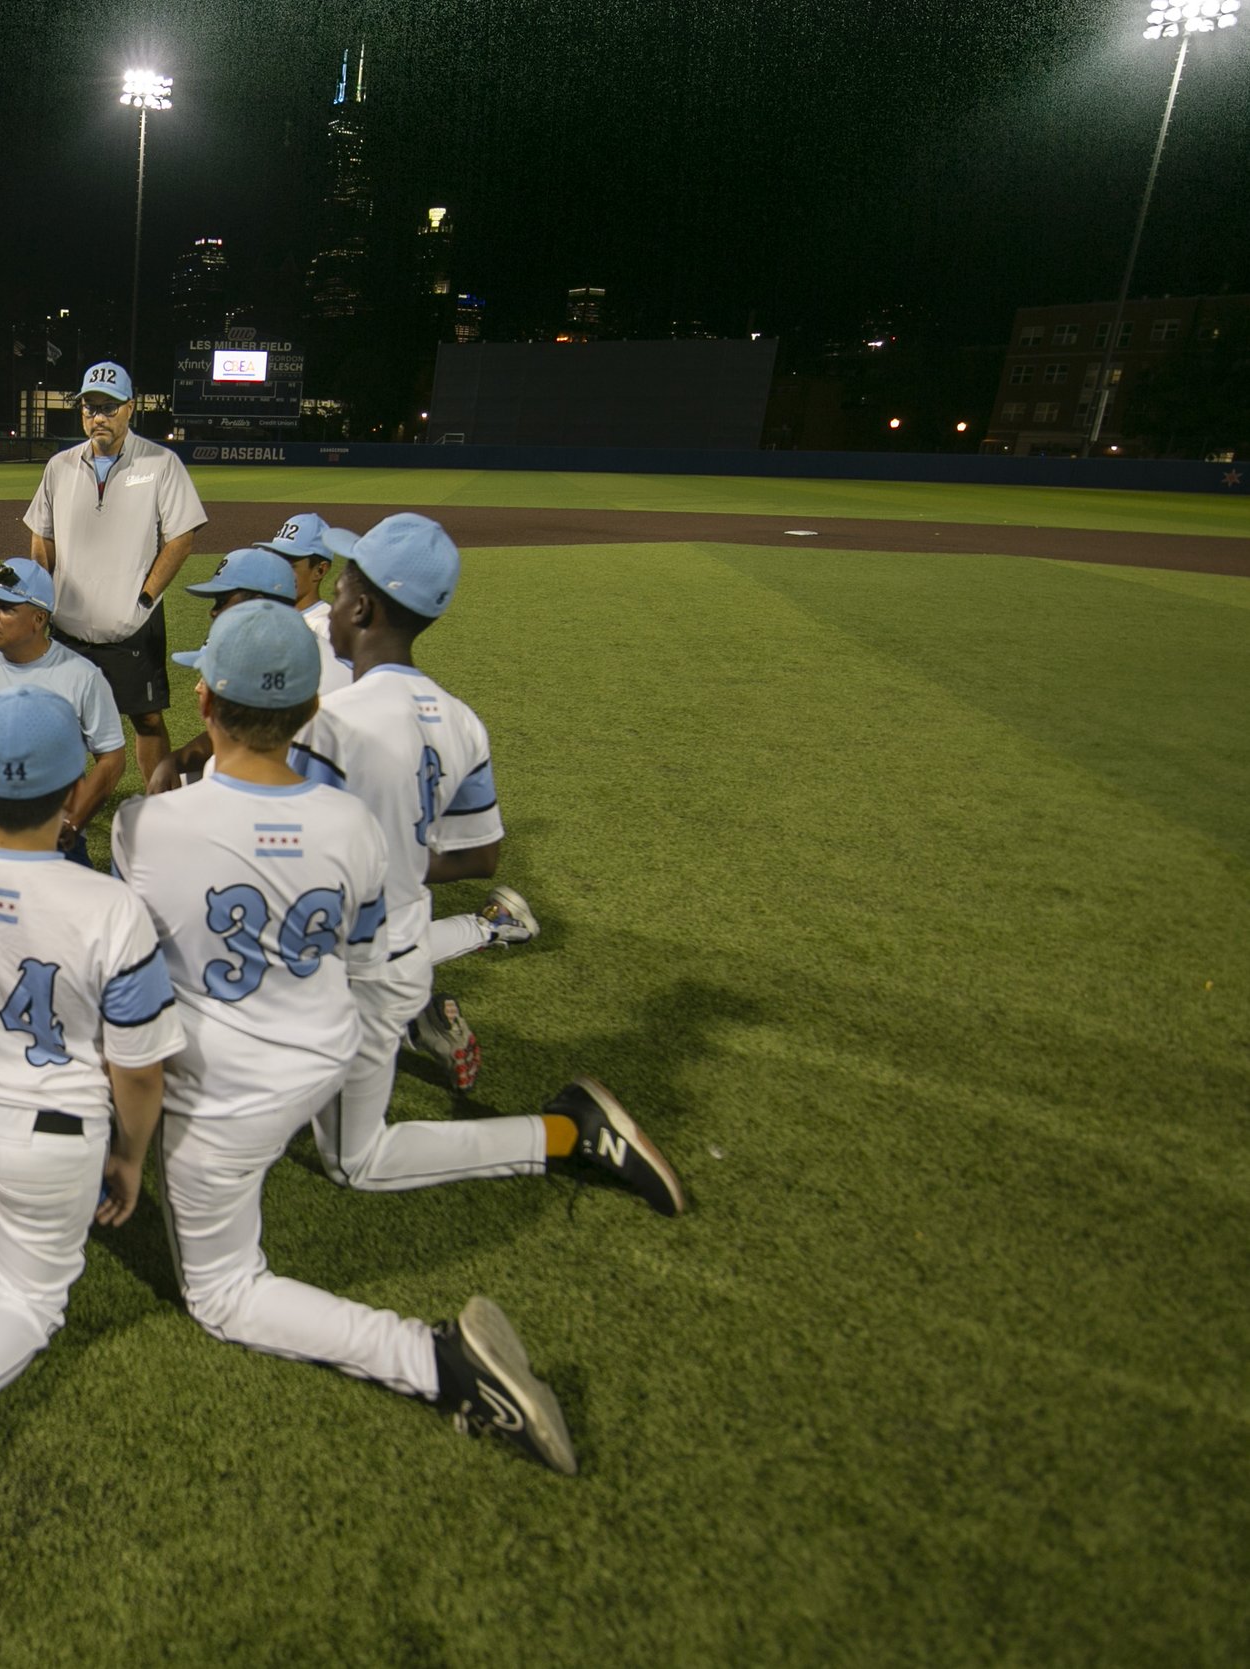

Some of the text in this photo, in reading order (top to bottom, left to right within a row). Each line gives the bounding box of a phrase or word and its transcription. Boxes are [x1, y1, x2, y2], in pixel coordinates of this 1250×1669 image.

[190, 341, 292, 352] LES MILLER FIELD
[178, 358, 211, 372] xfinity
[269, 362, 303, 371] FLESCH
[90, 368, 117, 384] 312
[220, 447, 286, 460] BASEBALL
[262, 672, 285, 691] 36
[3, 762, 27, 781] 44
[203, 881, 345, 1003] 36
